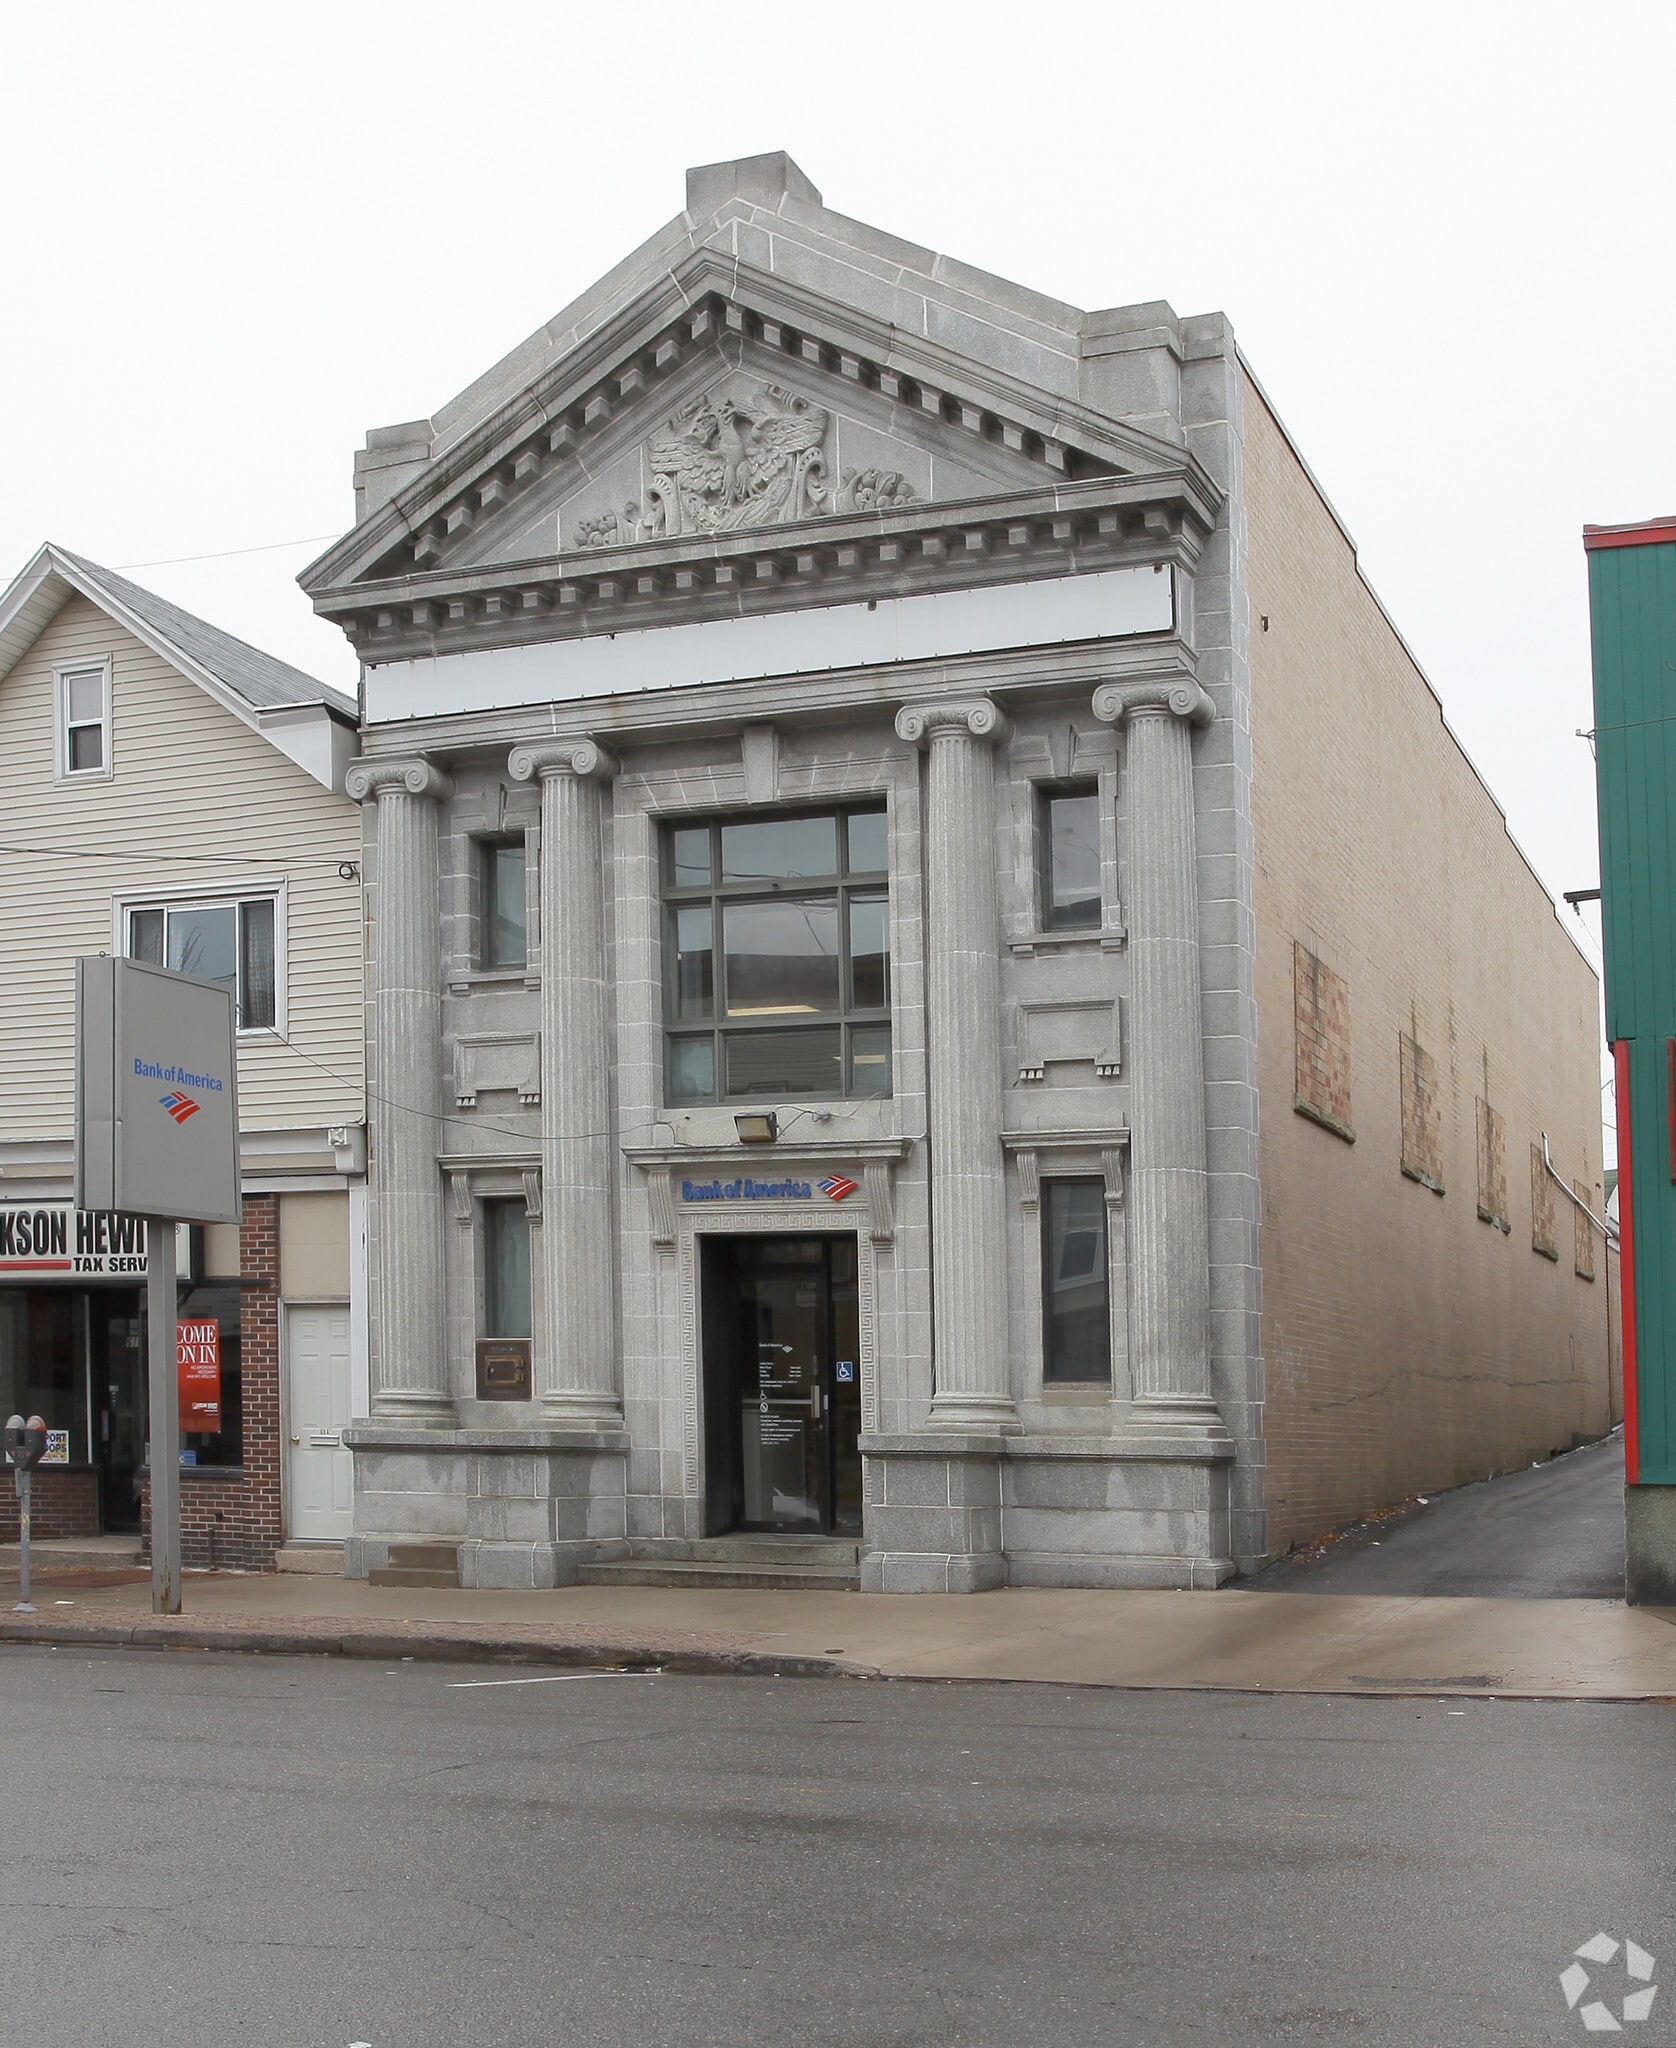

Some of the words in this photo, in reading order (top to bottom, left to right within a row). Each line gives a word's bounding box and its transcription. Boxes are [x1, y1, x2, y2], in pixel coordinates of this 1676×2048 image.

[133, 1057, 164, 1080] Bank
[164, 1066, 176, 1082] of
[177, 1067, 223, 1092] America
[682, 1179, 723, 1200] Bank
[725, 1178, 741, 1198] of
[743, 1178, 812, 1198] America
[0, 1210, 67, 1256] KSON
[76, 1211, 145, 1255] HEWI
[73, 1257, 103, 1273] TAX
[109, 1256, 148, 1273] SERV
[176, 1345, 196, 1364] ON
[200, 1345, 216, 1364] IN
